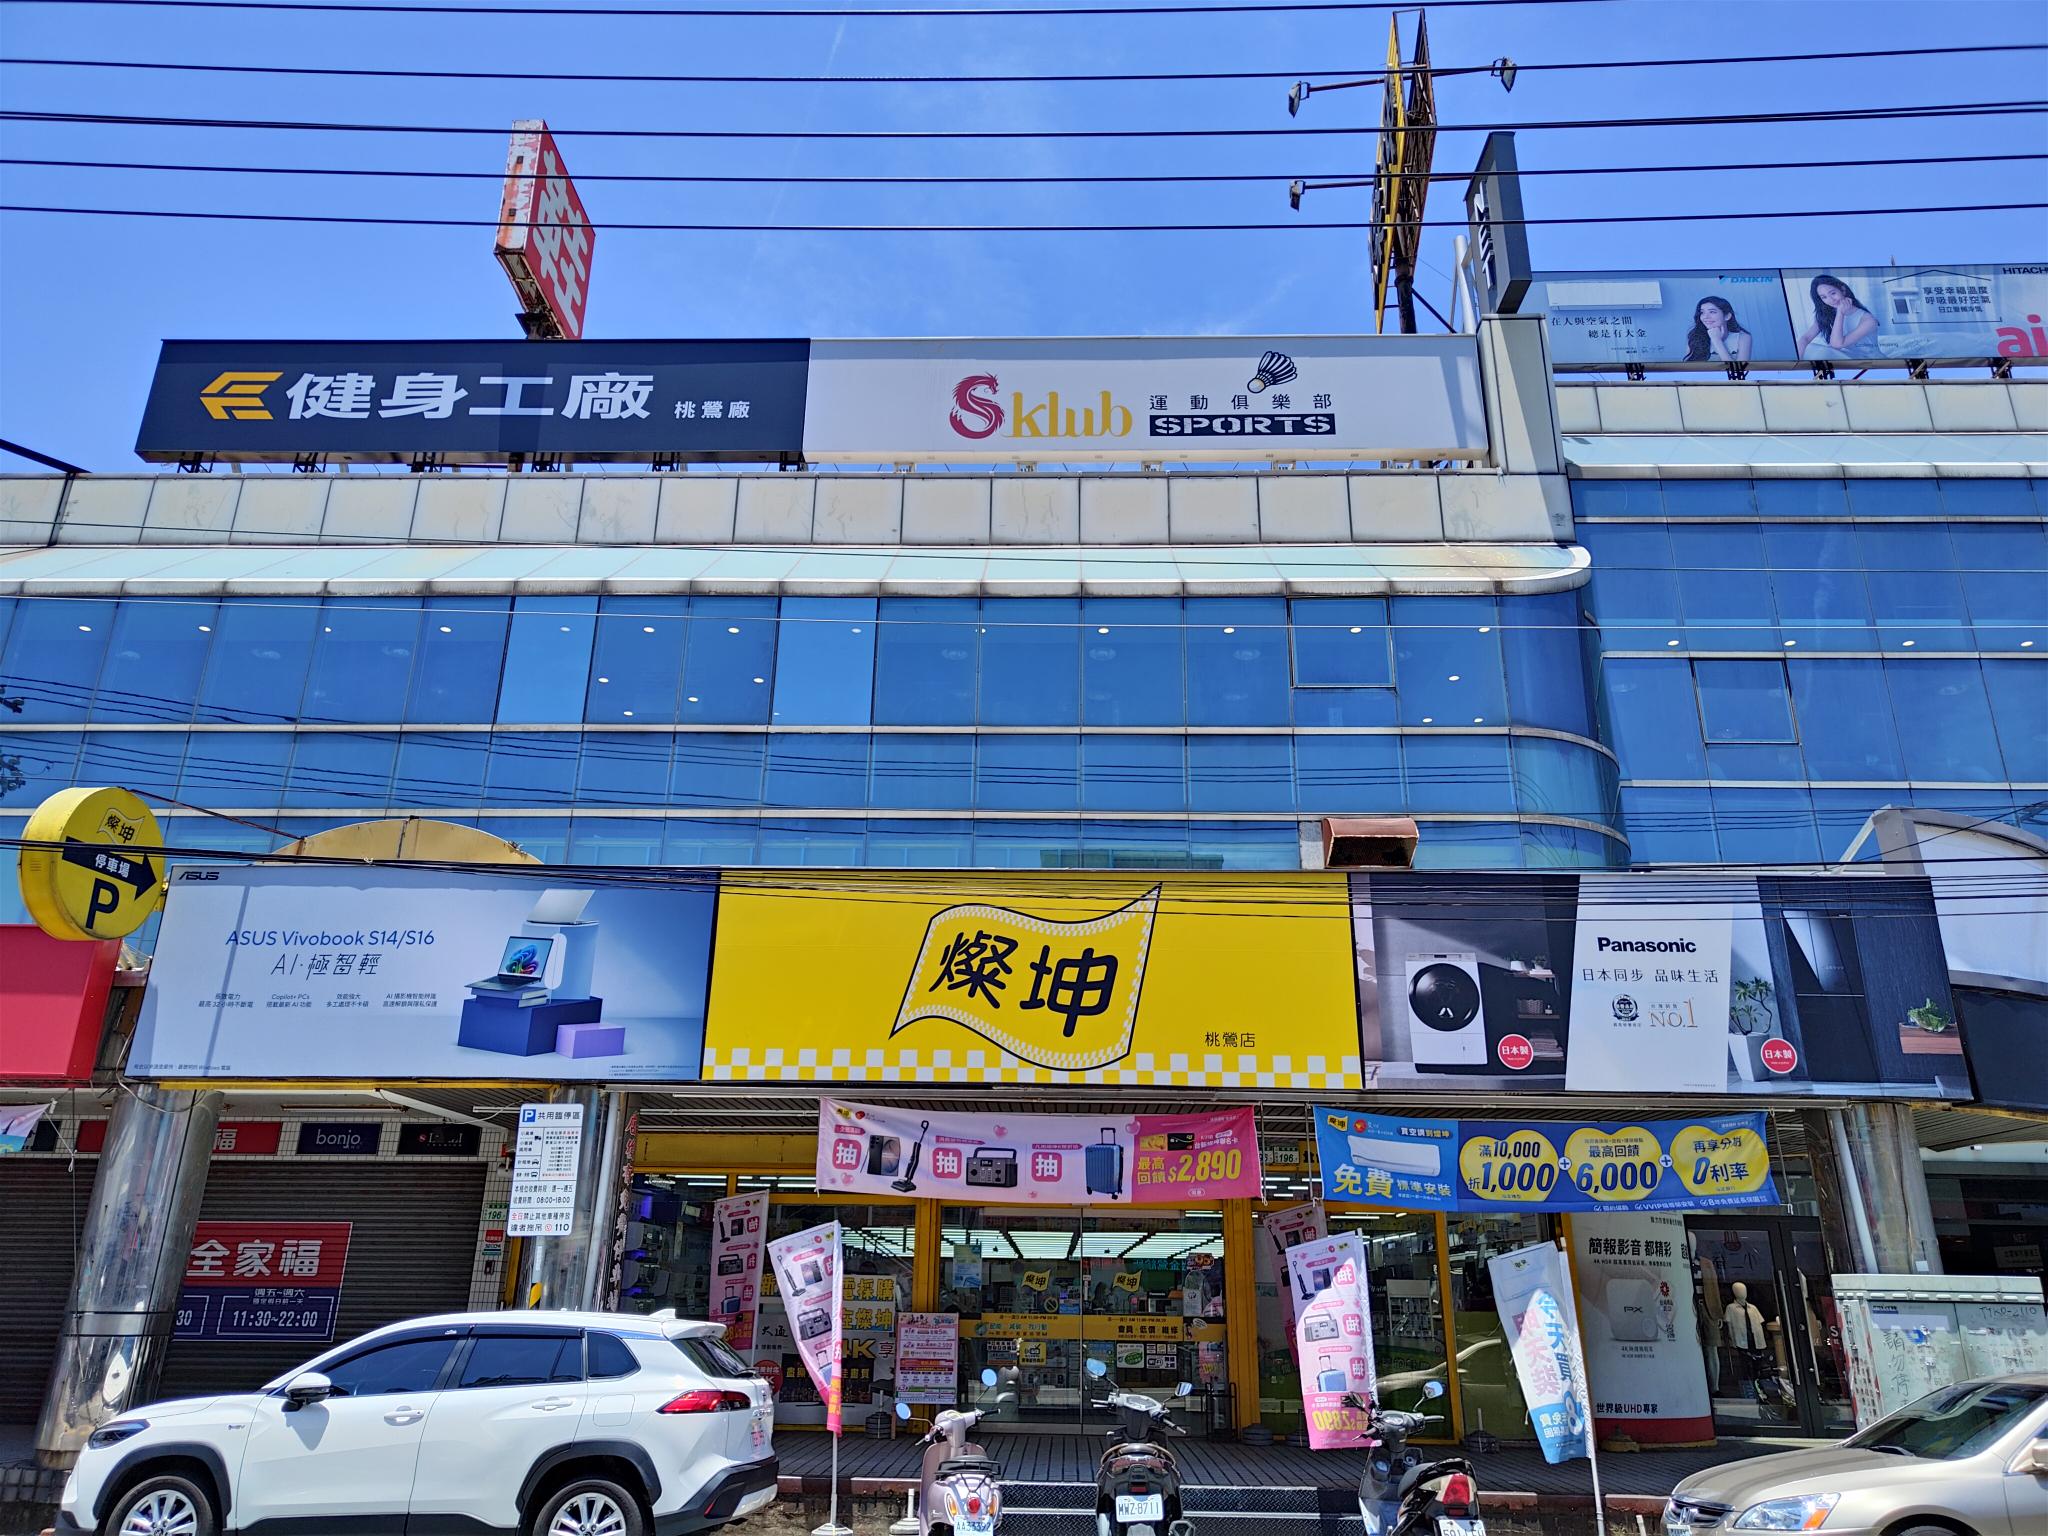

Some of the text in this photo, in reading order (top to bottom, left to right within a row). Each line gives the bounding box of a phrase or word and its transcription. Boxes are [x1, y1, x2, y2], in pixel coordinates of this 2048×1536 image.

[1730, 275, 1773, 284] DAIKIN
[1925, 296, 1992, 305] 呼吸最好空氣
[1551, 315, 1633, 327] 在人與空氣之間
[1588, 328, 1648, 339] 總是有大金
[285, 371, 655, 420] 健身工廠
[1149, 393, 1332, 411] 運動俱樂部
[674, 400, 751, 419] 桃鶯廠
[1153, 415, 1333, 435] SPORTS
[104, 815, 136, 843] 燦坤
[95, 854, 130, 879] 停車場
[178, 871, 220, 881] ASUS
[85, 877, 120, 930] P
[226, 930, 435, 949] ASUS Vivobook S14/S16
[1597, 936, 1697, 954] Panasonic
[929, 930, 1120, 1037] 燦坤
[1582, 967, 1720, 985] 日本同步 品味生活
[1204, 1031, 1256, 1049] 桃鶯店
[1502, 1045, 1529, 1055] 日本製
[1764, 1049, 1793, 1059] 日本製
[537, 1111, 581, 1120] 共用臨停區
[315, 1128, 361, 1148] bonjo
[836, 1142, 858, 1166] 抽
[1280, 1153, 1294, 1163] 196
[1588, 1144, 1640, 1158] 最高回饋
[936, 1151, 958, 1175] 抽
[1035, 1154, 1058, 1178] 抽
[1138, 1156, 1165, 1171] 最高
[1168, 1149, 1242, 1184] $2,890
[1138, 1171, 1166, 1185] 回饋
[1333, 1163, 1452, 1199] 免費 標準安裝
[1576, 1161, 1658, 1194] 6,000
[487, 1211, 502, 1220] 196
[510, 1223, 570, 1232] 違者拖吊 110
[1588, 1237, 1672, 1257] 簡報影音 都精彩
[186, 1238, 324, 1277] 全家福
[233, 1310, 318, 1328] 11:30~22:00
[1883, 1331, 1910, 1406] 請勿停
[1596, 1402, 1658, 1415] 世界級UHD專家
